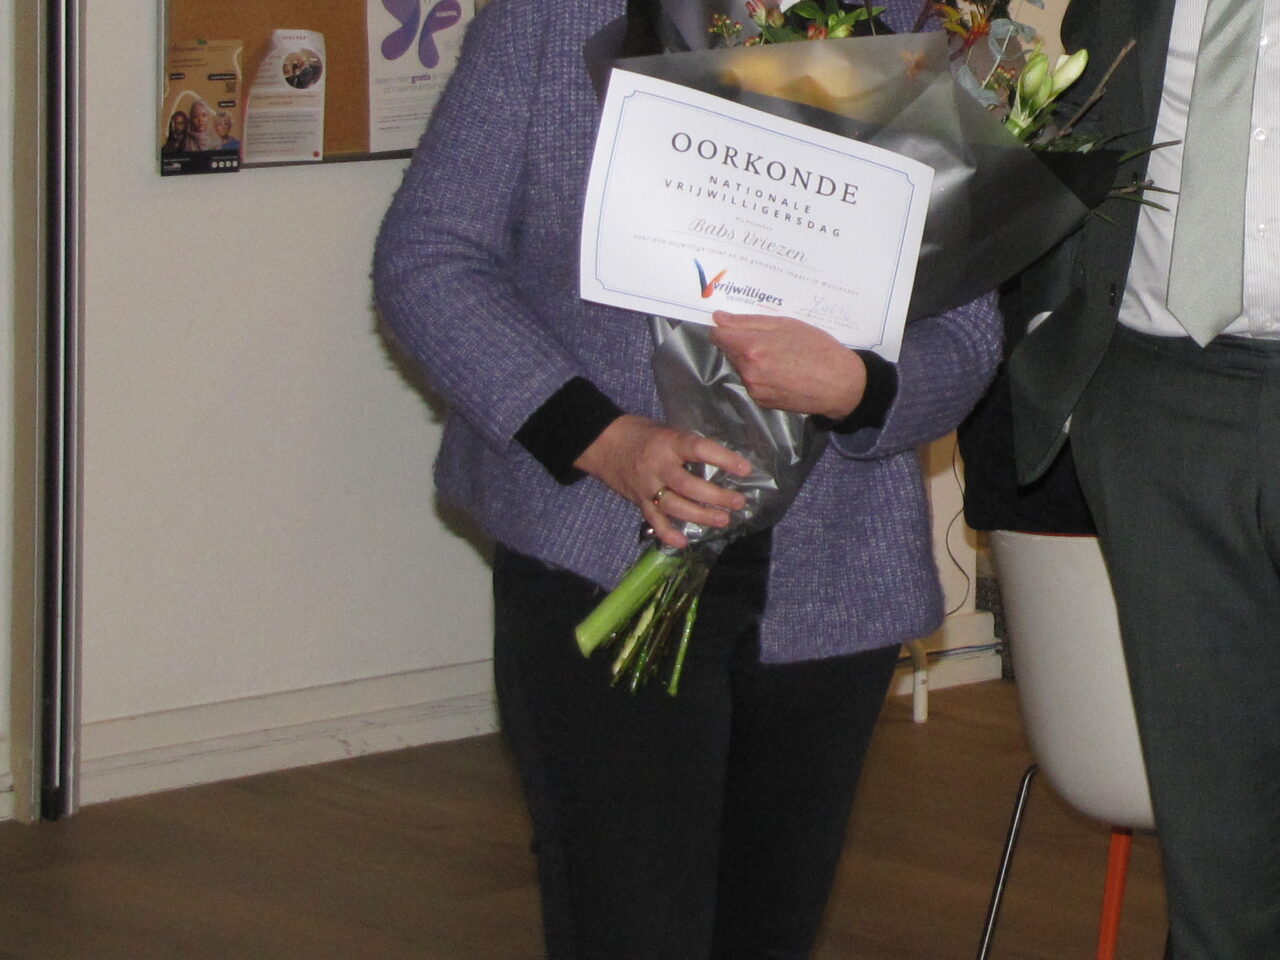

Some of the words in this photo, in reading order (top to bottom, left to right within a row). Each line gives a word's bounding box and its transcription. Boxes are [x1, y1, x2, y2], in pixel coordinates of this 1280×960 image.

[670, 131, 860, 206] OORKONDE
[663, 178, 843, 238] VRIJWILLIGERSDAG
[708, 174, 813, 215] NATIONALE
[688, 218, 735, 241] Babs
[743, 230, 808, 264] Vriezen
[713, 280, 785, 307] vrijwilligers
